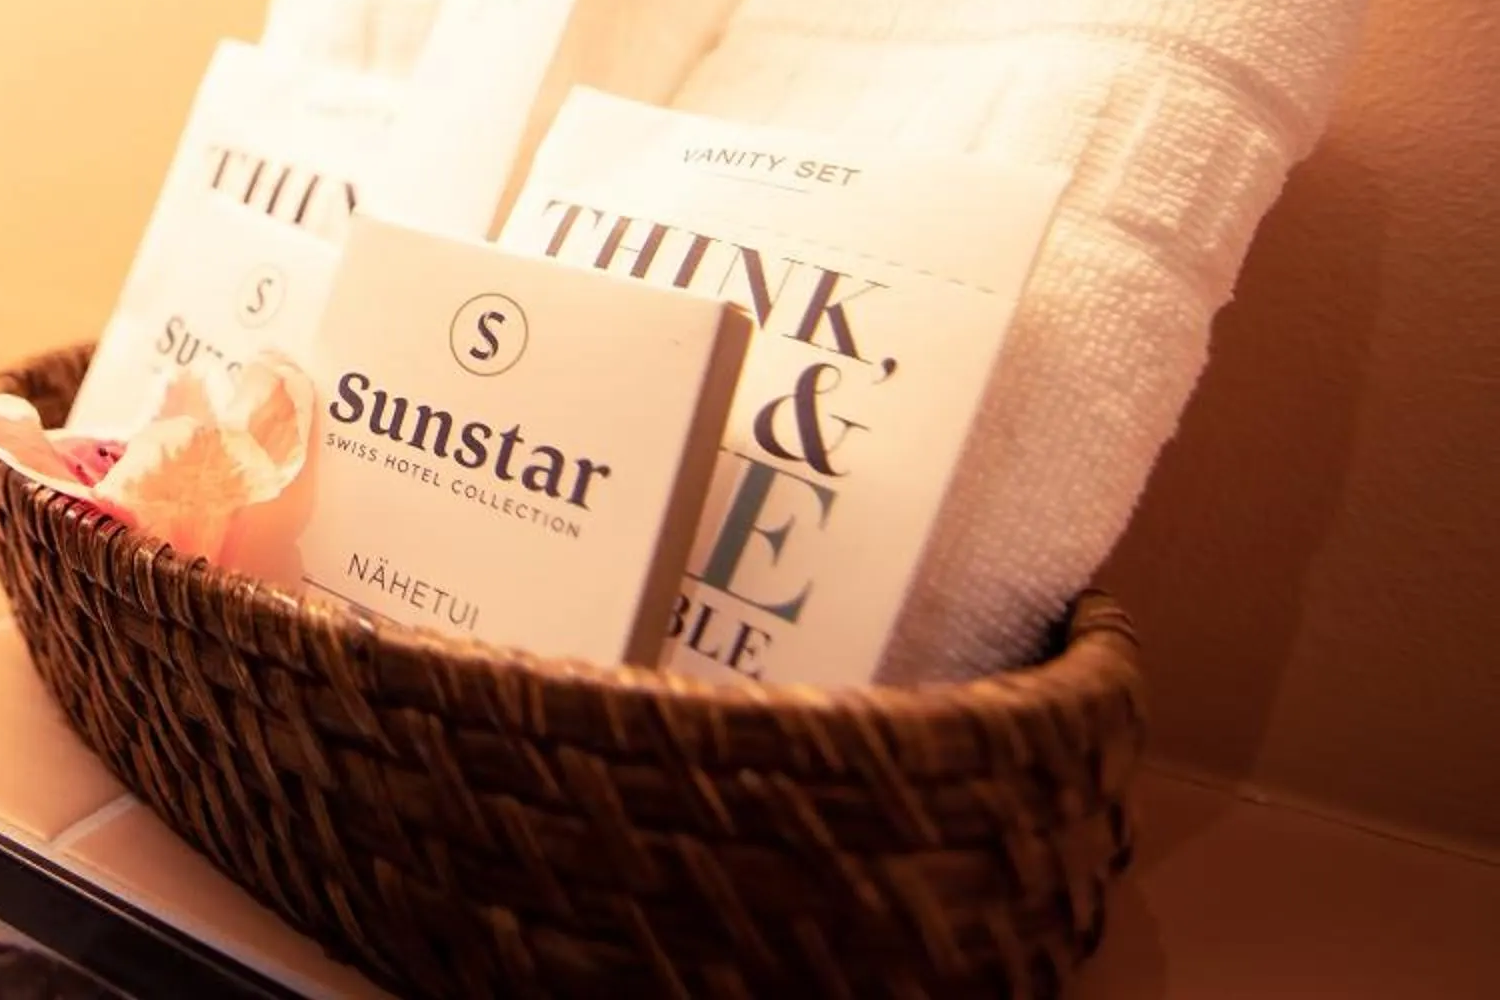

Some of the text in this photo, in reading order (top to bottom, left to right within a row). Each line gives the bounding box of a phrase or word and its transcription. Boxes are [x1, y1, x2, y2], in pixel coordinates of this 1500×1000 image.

[682, 148, 862, 187] VANITY SET
[469, 311, 506, 361] S
[328, 372, 612, 512] Sunstar
[753, 363, 870, 477] &
[326, 432, 581, 540] SWISS HOTEL COLLECTION
[347, 552, 480, 631] NÄHETUI
